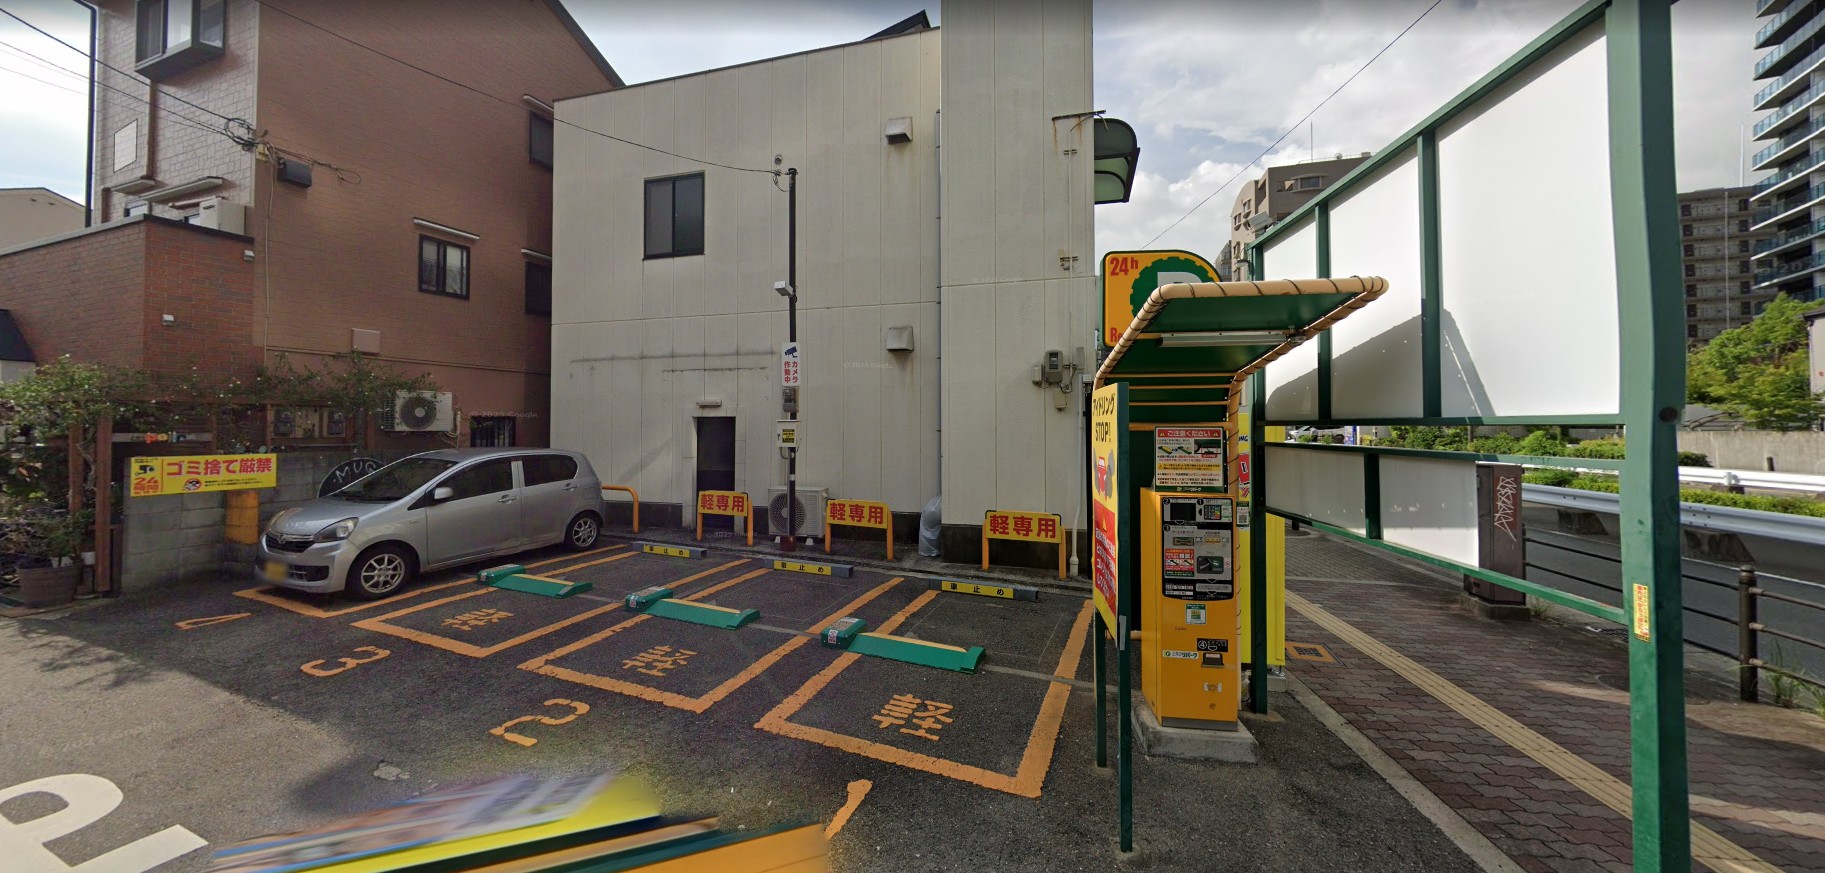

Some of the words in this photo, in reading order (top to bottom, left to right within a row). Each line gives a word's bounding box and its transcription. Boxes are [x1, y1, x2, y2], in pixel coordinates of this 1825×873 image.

[1110, 257, 1138, 276] 24h
[1096, 422, 1111, 442] STOP!
[166, 458, 272, 476] ゴミ捨て厳禁
[134, 477, 159, 486] 24
[700, 493, 745, 513] 軽専用
[830, 502, 884, 524] 軽専用
[990, 514, 1057, 538] 軽専用
[648, 545, 690, 556] 車止め
[780, 562, 824, 573] 車止め
[950, 582, 1004, 596] 車止め
[442, 608, 513, 632] 軽
[300, 646, 391, 678] 3
[622, 646, 697, 676] 軽
[488, 698, 590, 746] 2
[872, 694, 954, 740] 軽
